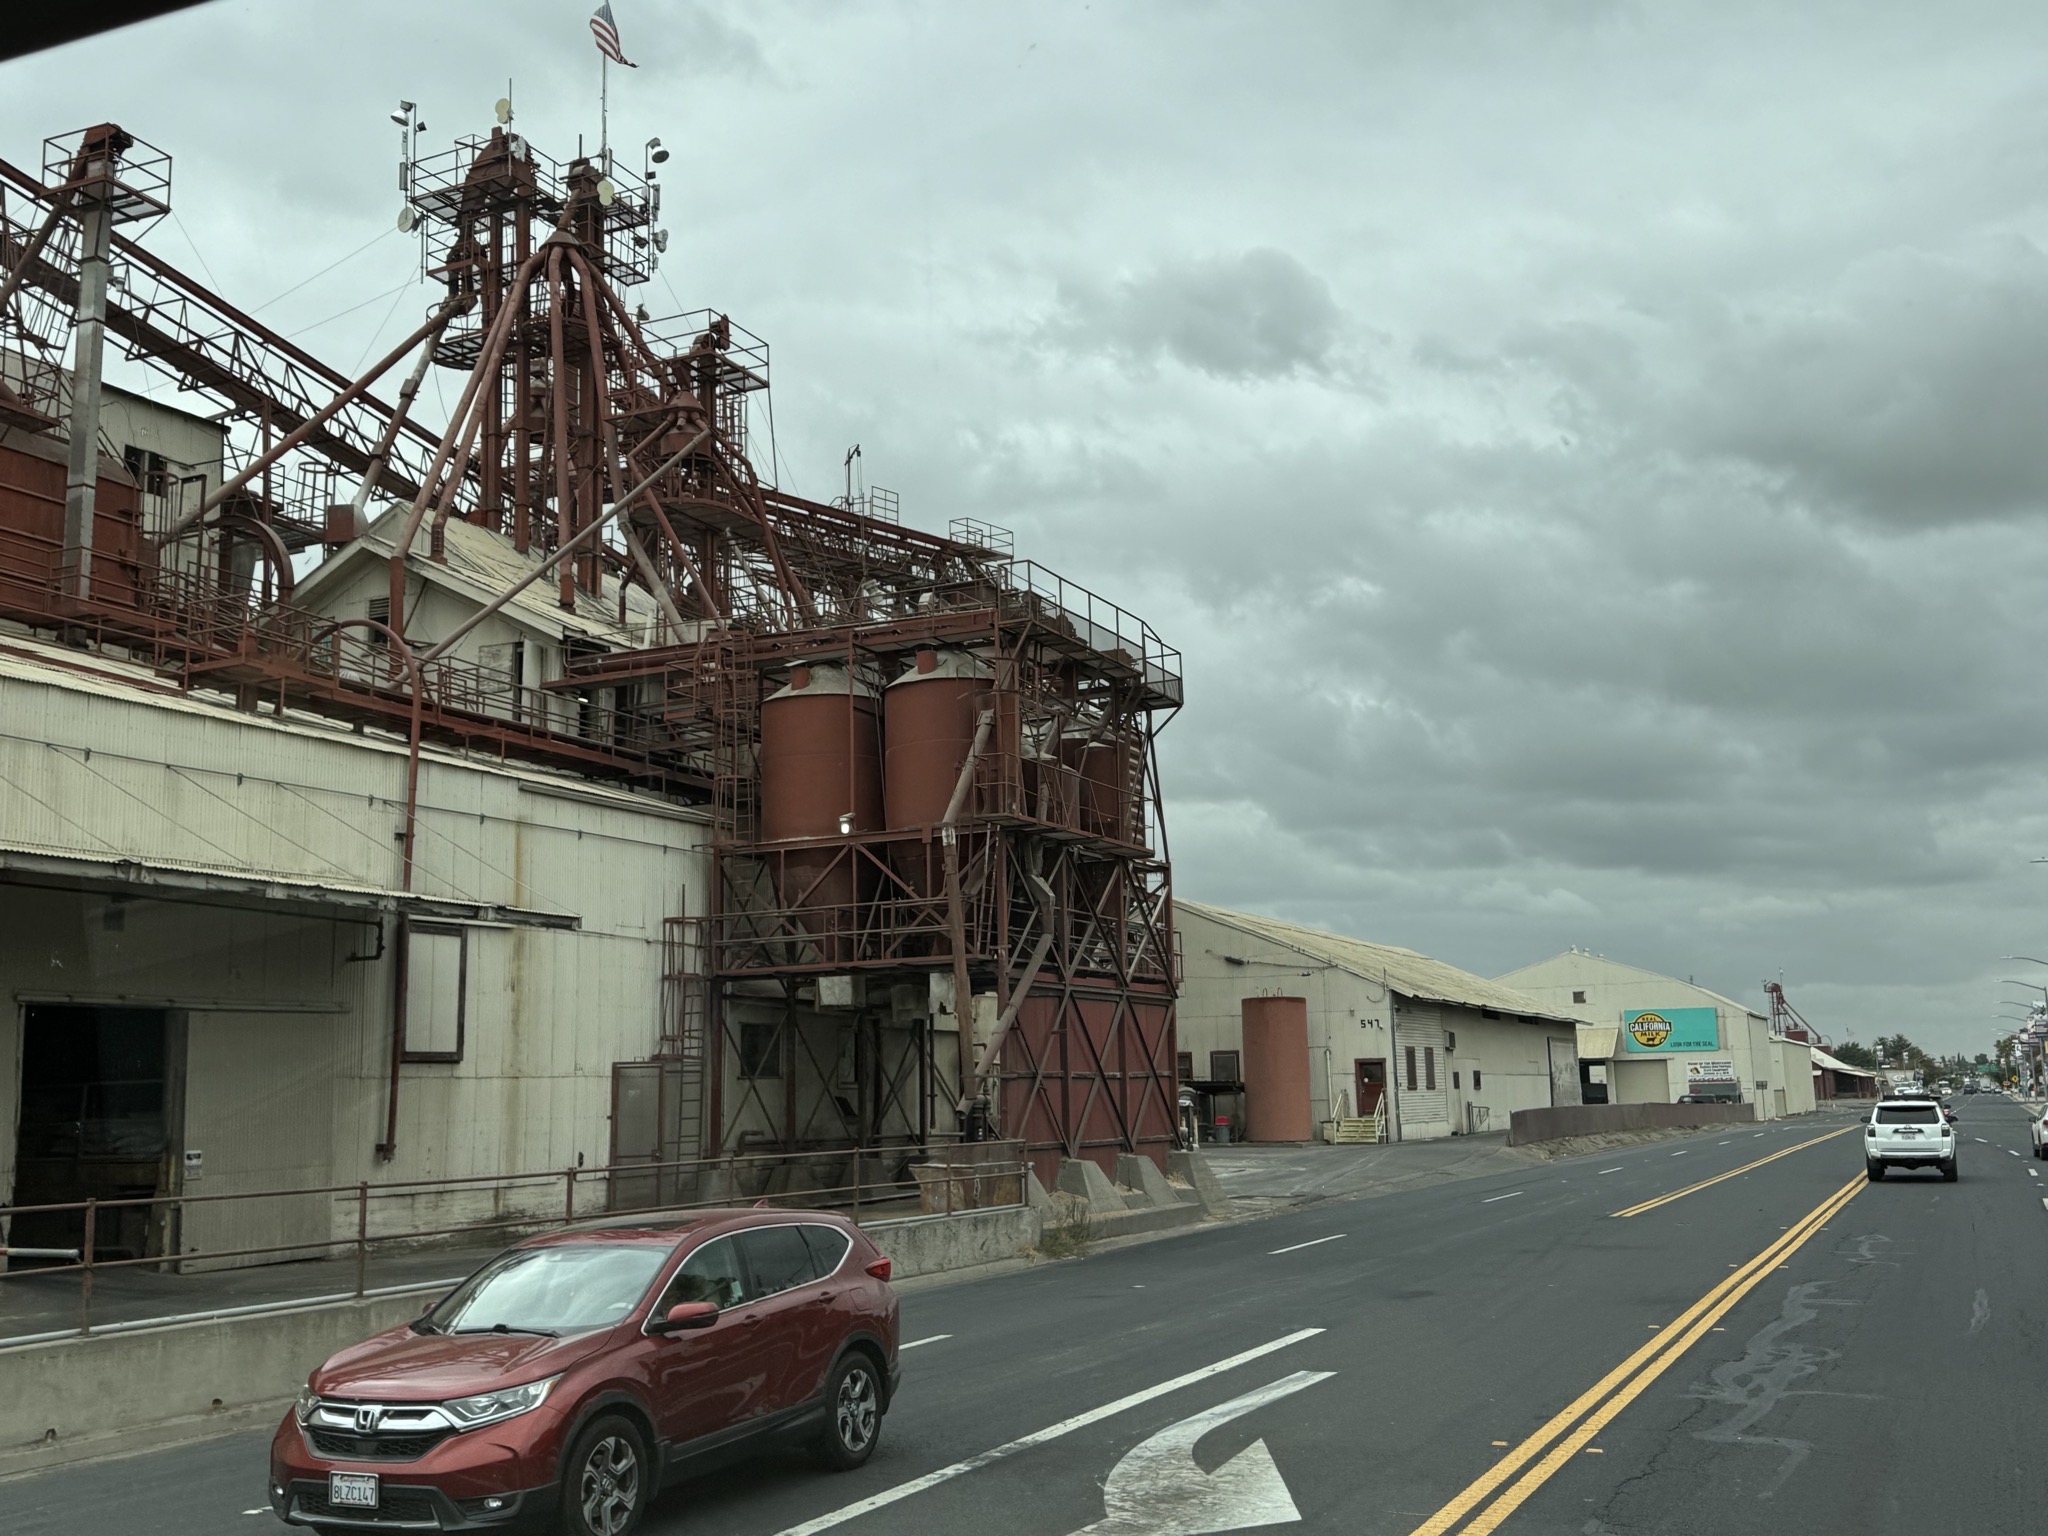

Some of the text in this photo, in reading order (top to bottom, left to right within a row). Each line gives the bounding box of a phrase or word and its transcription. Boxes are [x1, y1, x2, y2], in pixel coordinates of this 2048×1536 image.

[1360, 1019, 1380, 1029] 547
[1630, 1022, 1670, 1032] CALIFORNIA
[334, 1485, 375, 1502] 8LZC147
